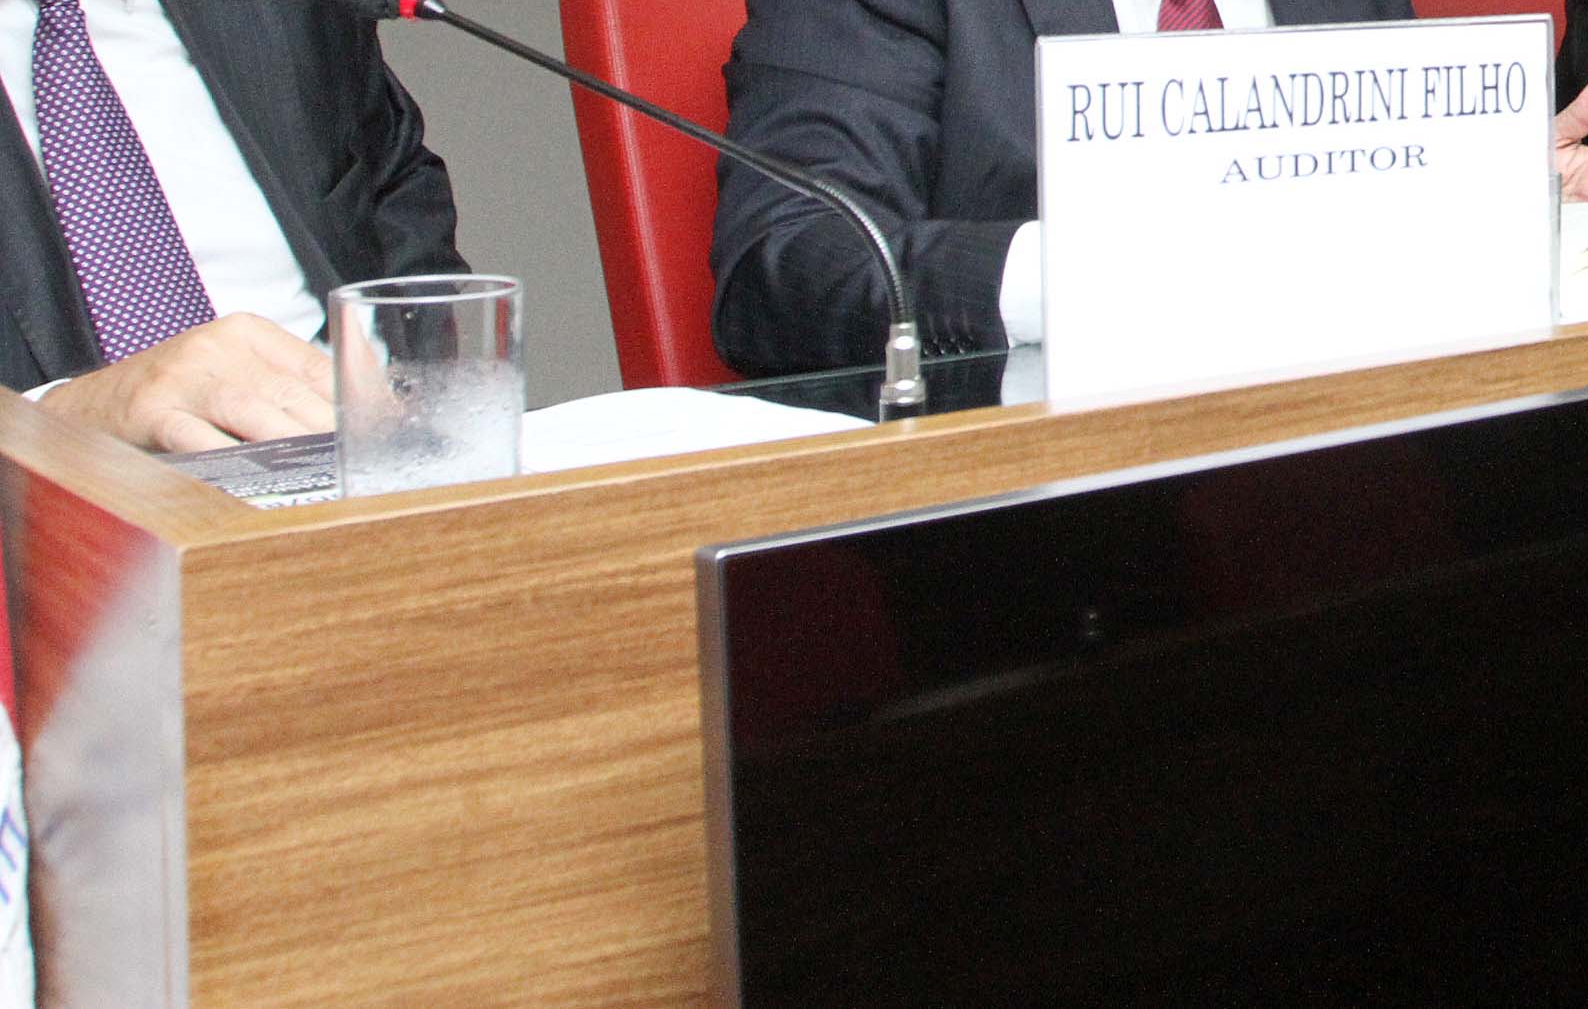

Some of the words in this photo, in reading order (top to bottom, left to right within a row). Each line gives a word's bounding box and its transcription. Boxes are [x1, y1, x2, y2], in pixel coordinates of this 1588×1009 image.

[1067, 81, 1145, 142] RUI
[1161, 67, 1408, 136] CALANDRINI
[1421, 62, 1527, 119] FILHO
[1220, 144, 1428, 184] AUDITOR
